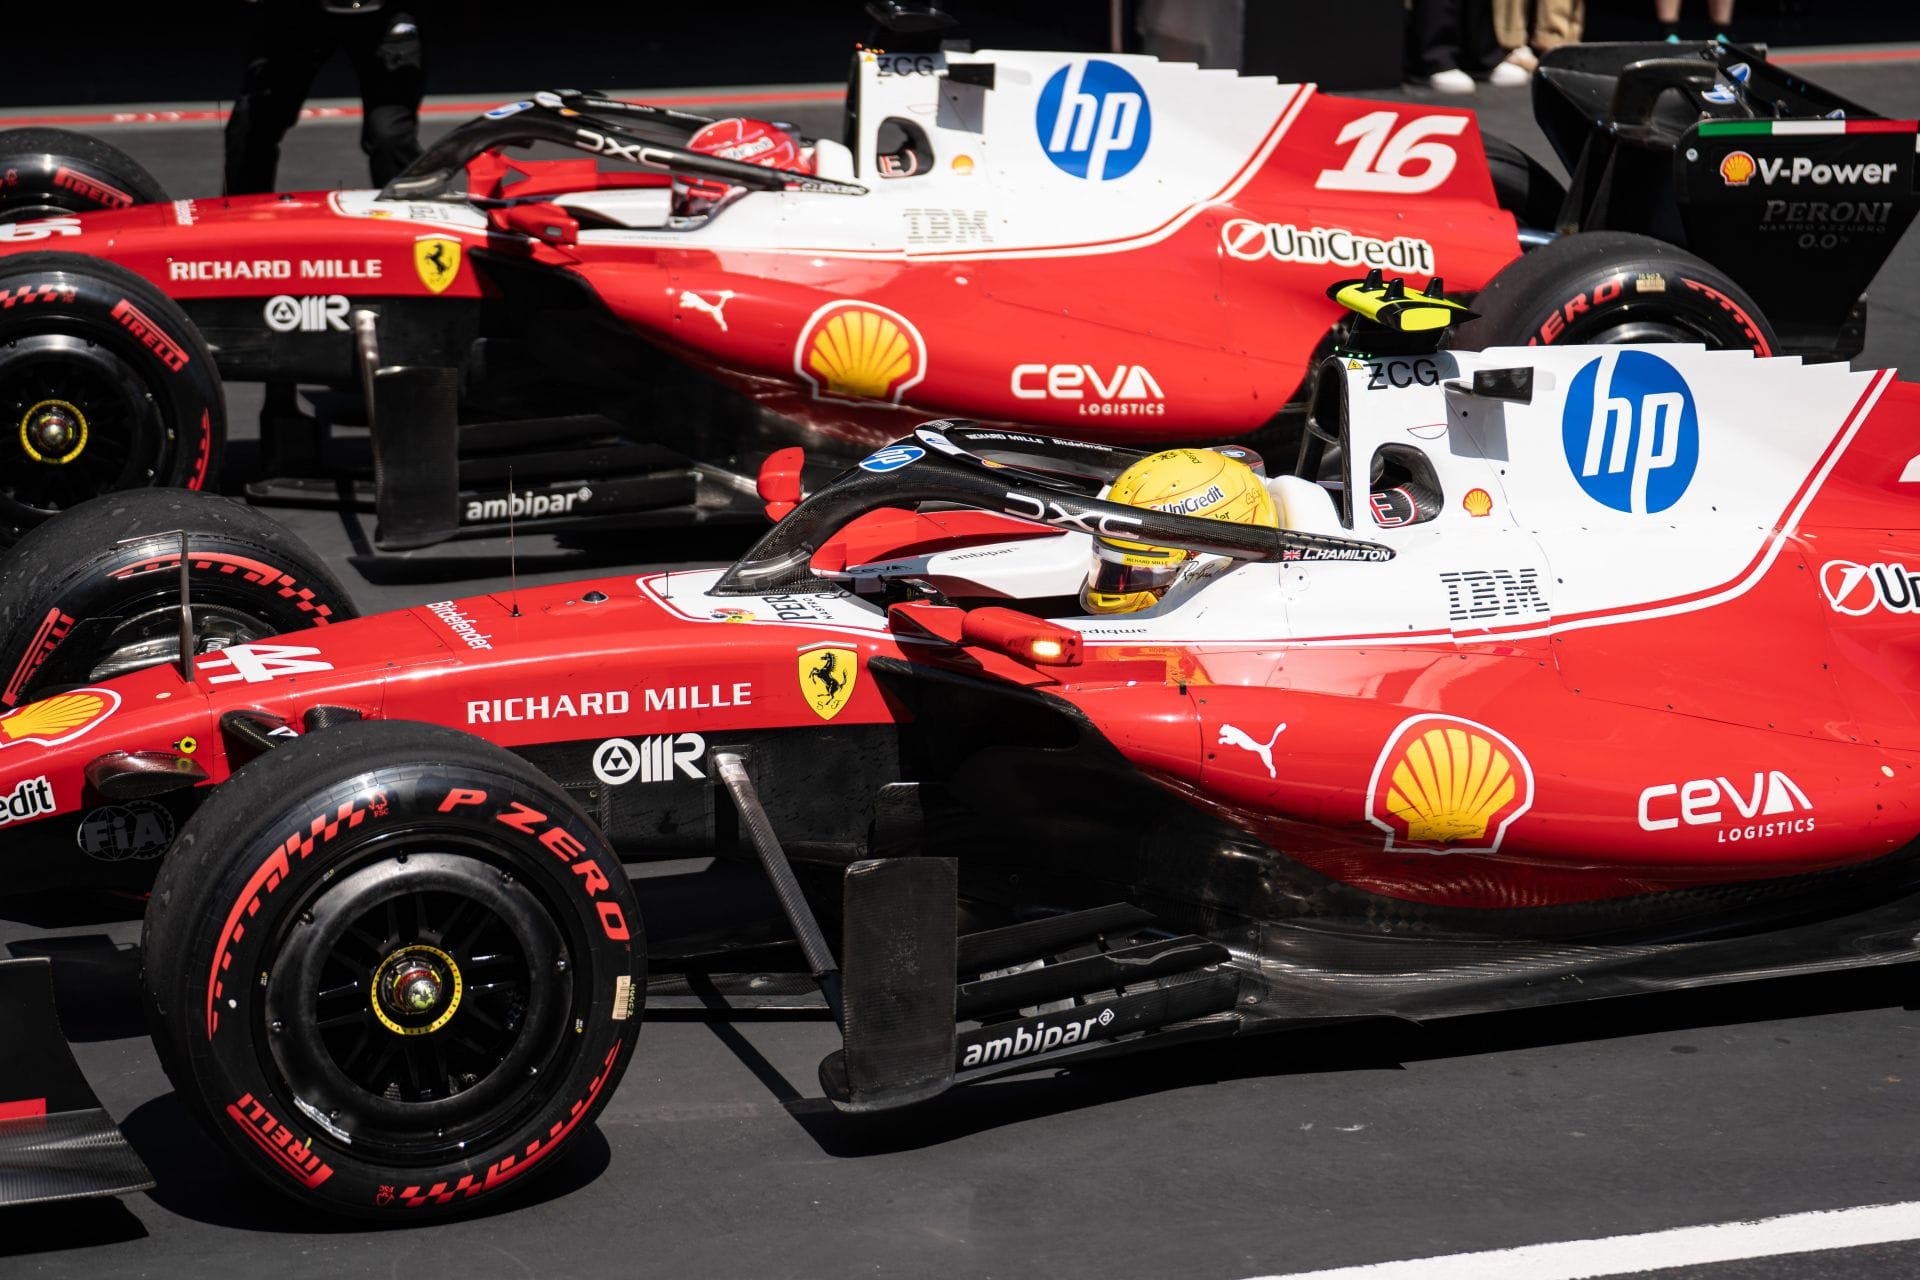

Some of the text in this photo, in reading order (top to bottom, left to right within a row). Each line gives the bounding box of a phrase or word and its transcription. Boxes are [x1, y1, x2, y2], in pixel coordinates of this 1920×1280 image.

[877, 55, 934, 77] ZCG
[1048, 59, 1142, 181] hp
[574, 128, 674, 170] DXC
[1315, 111, 1470, 195] 16
[1757, 156, 1898, 185] V-Power
[904, 208, 995, 243] IBM
[1762, 200, 1894, 223] PERONI
[169, 258, 383, 281] RICHARD MILLE
[1270, 226, 1431, 271] UniCredit
[110, 298, 191, 373] PIRELLI
[1363, 358, 1441, 391] ZCG
[1078, 402, 1166, 417] LOGISTICS
[1007, 434, 1045, 445] MILLE
[1581, 350, 1686, 514] hp
[465, 490, 579, 521] ambipar
[1004, 491, 1144, 540] DXC
[1302, 549, 1391, 561] L.HAMILTON
[1439, 568, 1551, 621] IBM
[425, 600, 494, 651] Bitdefender
[196, 643, 336, 685] 44
[466, 681, 753, 725] RICHARD MILLE
[1717, 817, 1816, 844] LOGISTICS
[436, 787, 631, 941] P ZERO
[962, 1016, 1098, 1068] ambipar
[226, 1092, 335, 1190] PIRELLI
